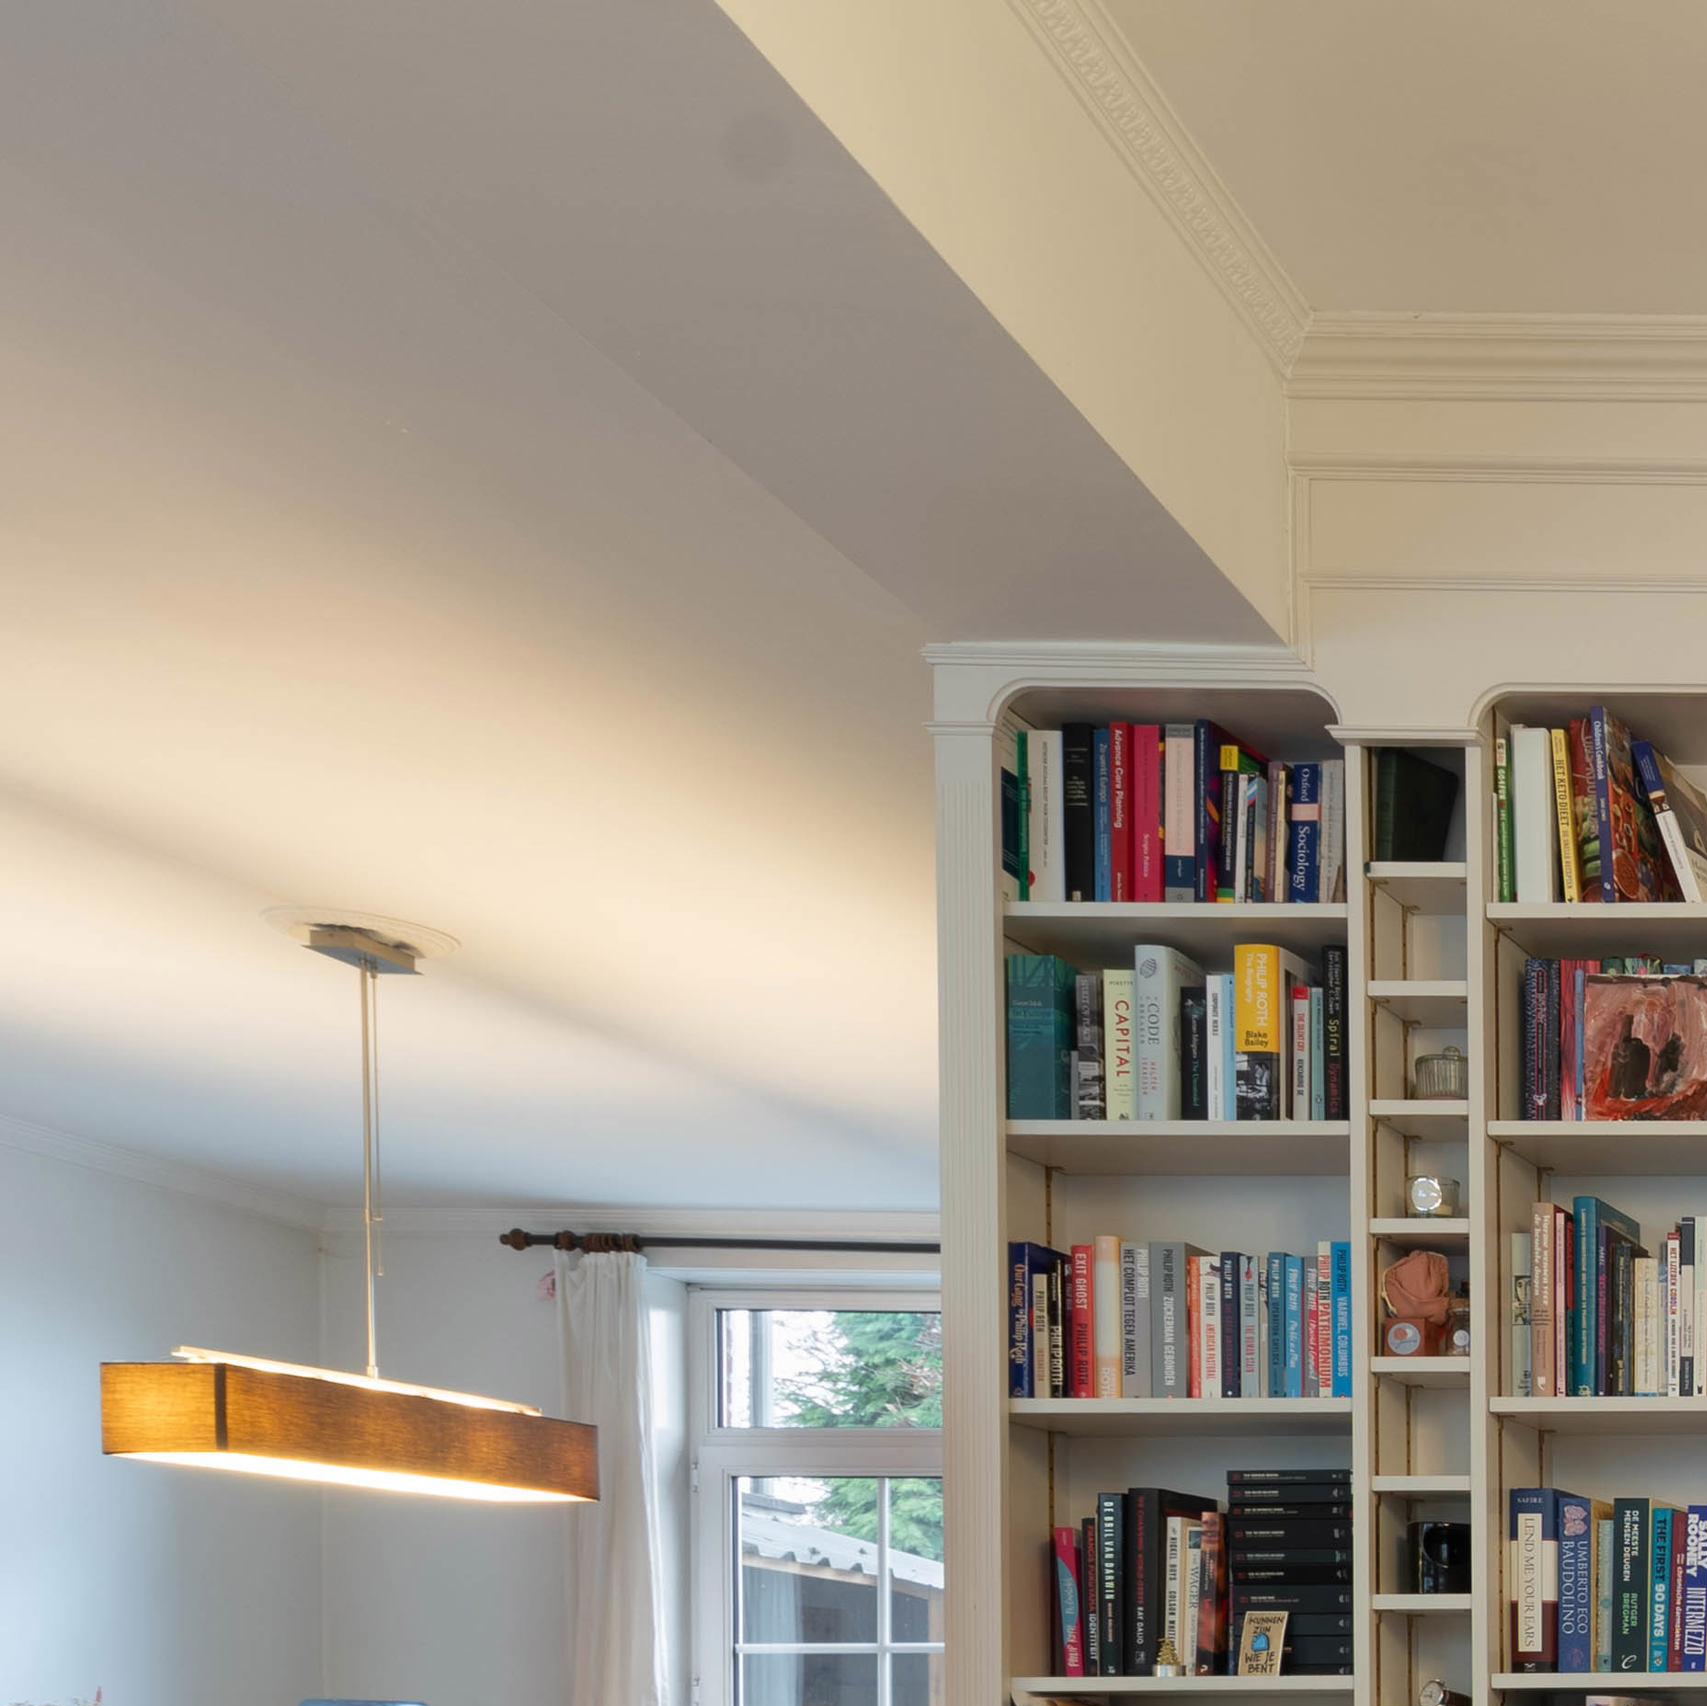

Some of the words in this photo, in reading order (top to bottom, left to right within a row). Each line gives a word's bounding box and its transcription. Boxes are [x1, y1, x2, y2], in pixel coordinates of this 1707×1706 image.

[1115, 728, 1124, 766] Advance
[1115, 768, 1124, 789] Care
[1556, 759, 1566, 775] HET
[1300, 768, 1310, 802] Oxford
[1558, 778, 1567, 799] KETO
[1113, 790, 1124, 828] Planning
[1559, 802, 1569, 827] DIEET
[1294, 826, 1308, 892] Sociology
[1257, 953, 1267, 988] PHILIP
[1148, 1002, 1160, 1046] CODE
[1256, 992, 1268, 1026] ROTH
[1115, 1000, 1131, 1078] CAPITAL
[1328, 1019, 1339, 1056] Spiral
[1328, 1064, 1340, 1114] Dynamics
[1075, 1253, 1086, 1274] EXIT
[1124, 1249, 1135, 1264] HET
[1137, 1249, 1149, 1276] PHILIP
[1163, 1249, 1173, 1272] PHILIP
[1319, 1255, 1330, 1279] PHILIP
[1337, 1249, 1347, 1272] PHILIP
[1076, 1278, 1087, 1309] GHOST
[1124, 1267, 1135, 1306] COMPLOT
[1138, 1277, 1149, 1298] ROTH
[1164, 1273, 1173, 1292] ROTH
[1245, 1284, 1254, 1301] PHILIP
[1319, 1281, 1330, 1300] ROTH
[1337, 1274, 1347, 1292] ROTH
[1124, 1309, 1135, 1335] TEGEN
[1163, 1296, 1174, 1343] ZUCKERMAN
[1246, 1303, 1254, 1317] ROTH
[1337, 1296, 1348, 1333] VAARWEL,
[1014, 1314, 1027, 1340] Philip
[1050, 1326, 1062, 1357] PHILIP
[1076, 1323, 1088, 1355] PHILIP
[1206, 1324, 1216, 1351] AMERICAN
[1009, 1342, 1026, 1363] Roth
[1124, 1338, 1136, 1376] AMERIKA
[1320, 1302, 1330, 1388] PATRIMONIUM
[1338, 1335, 1348, 1376] COLUMBUS
[1051, 1358, 1062, 1385] ROTH
[1077, 1360, 1088, 1385] ROTH
[1164, 1345, 1174, 1386] GEBONDEN
[1207, 1353, 1216, 1379] PASTORAL
[1104, 1501, 1114, 1512] DE
[1632, 1510, 1639, 1521] DE
[1104, 1516, 1114, 1538] BRIL
[1524, 1517, 1536, 1553] LEND
[1656, 1518, 1667, 1546] THE
[1104, 1541, 1114, 1558] VAN
[1686, 1513, 1699, 1577] ROONEY
[1524, 1555, 1536, 1575] ME
[1577, 1541, 1587, 1603] UMBERTO
[1656, 1548, 1666, 1580] FIRST
[1104, 1562, 1115, 1599] DARWIN
[1189, 1566, 1199, 1609] WAGER
[1524, 1577, 1536, 1613] YOUR
[1562, 1541, 1575, 1634] BAUDOLINO
[1675, 1566, 1683, 1604] chronische
[1578, 1608, 1588, 1634] ECO
[1622, 1593, 1630, 1634] BREGMAN
[1654, 1604, 1665, 1637] DAYS
[1674, 1606, 1682, 1650] darmziekten
[1684, 1587, 1706, 1654] INTERMEZZO
[1088, 1613, 1097, 1659] IDENTITEIT
[1524, 1616, 1535, 1647] EARS
